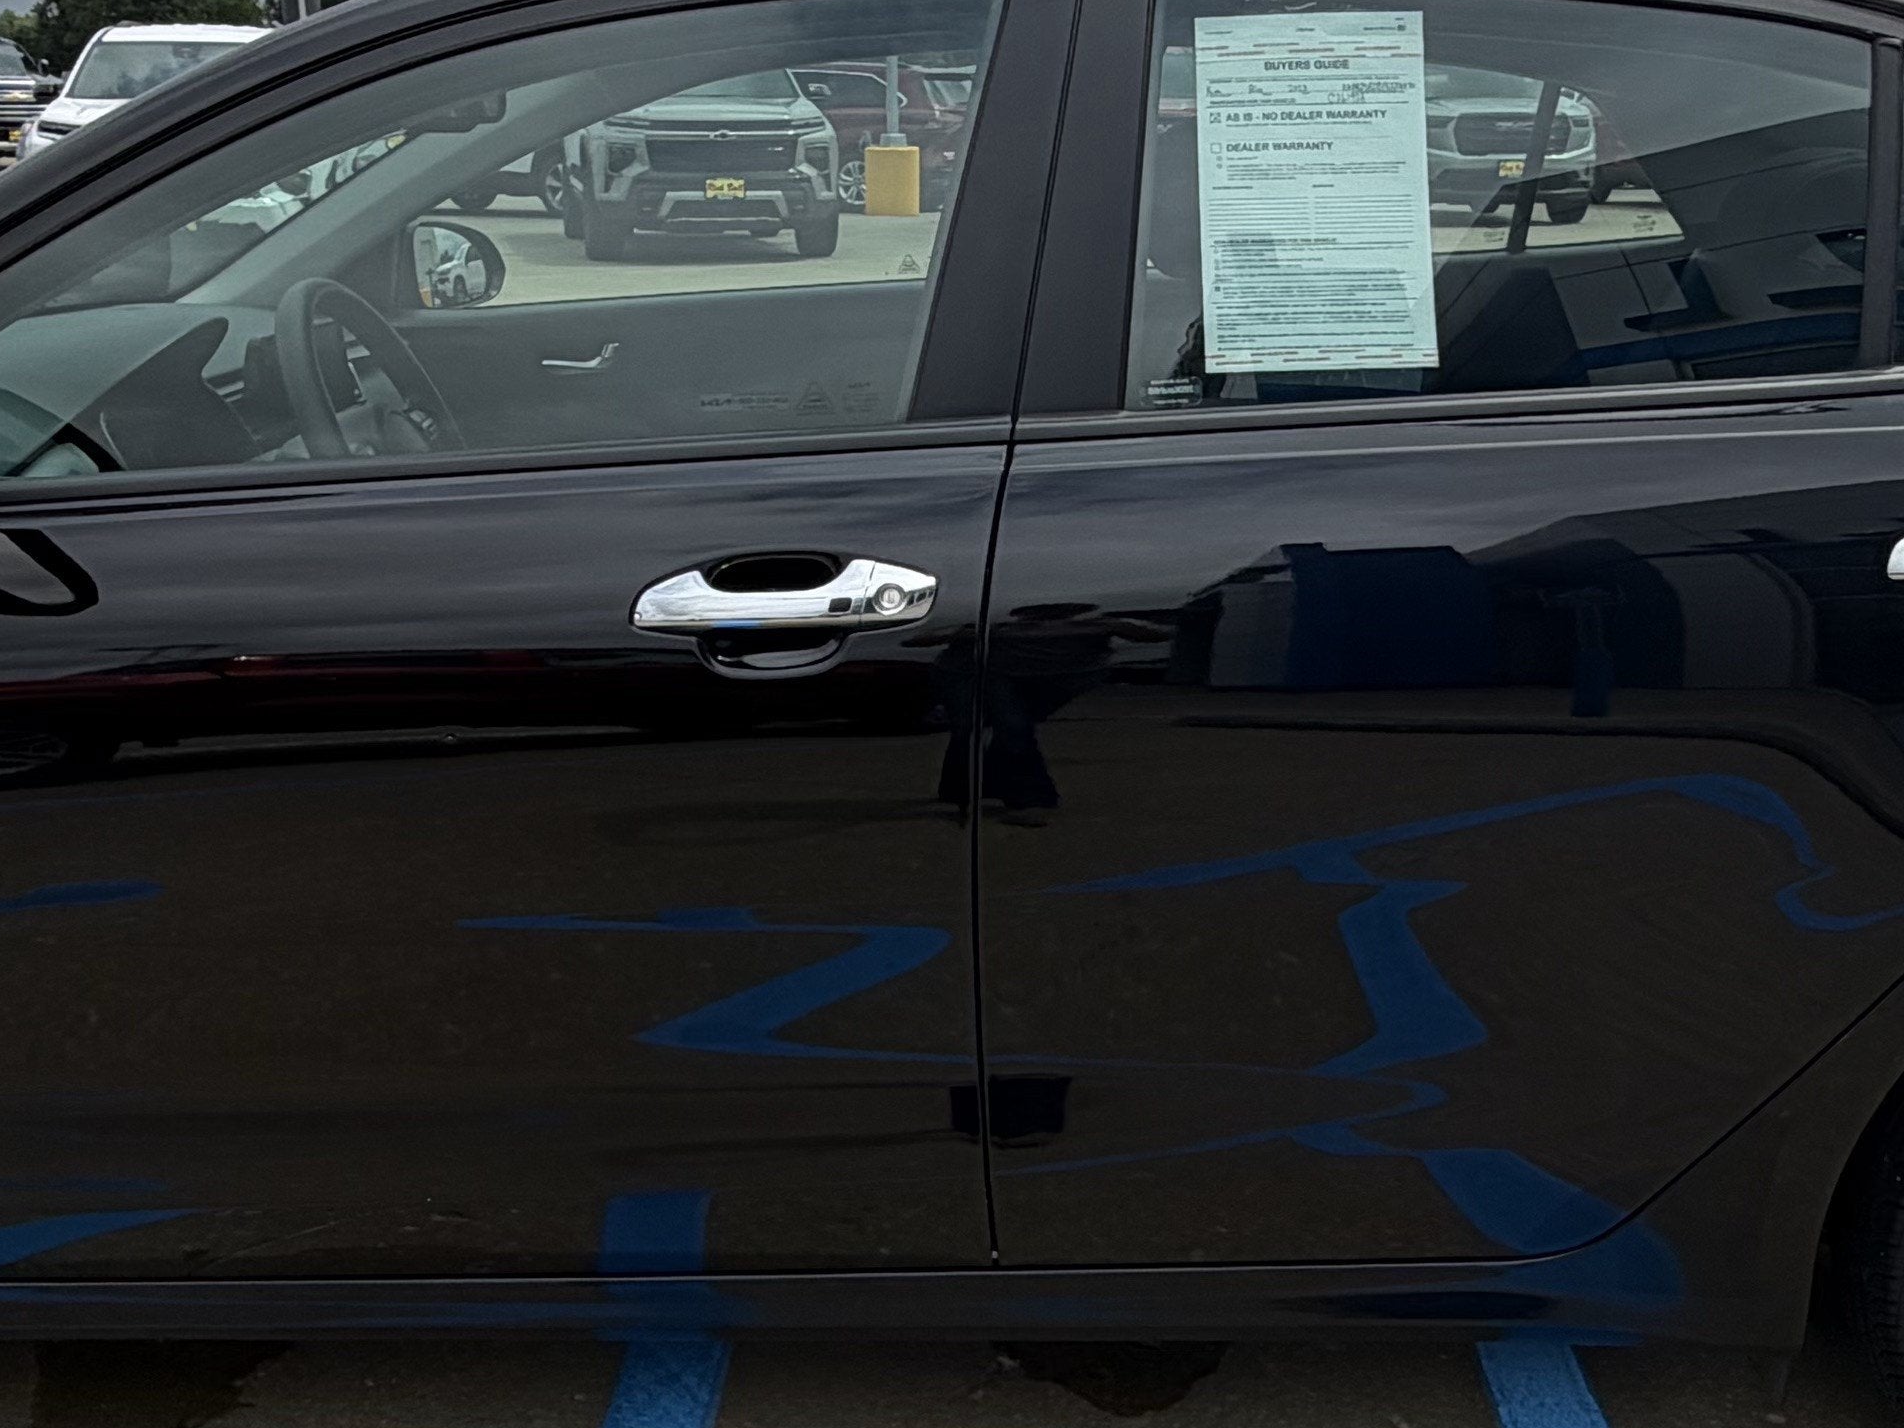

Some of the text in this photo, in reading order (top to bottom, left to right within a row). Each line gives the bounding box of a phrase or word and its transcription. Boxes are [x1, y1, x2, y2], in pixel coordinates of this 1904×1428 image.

[1264, 59, 1350, 71] BUYERS GUIDE
[1226, 113, 1240, 122] AS
[1243, 112, 1253, 121] IS
[1262, 111, 1278, 121] NO
[1281, 110, 1323, 120] DEALER
[1326, 109, 1387, 120] WARRANTY
[1226, 141, 1334, 152] DEALER WARRANTY
